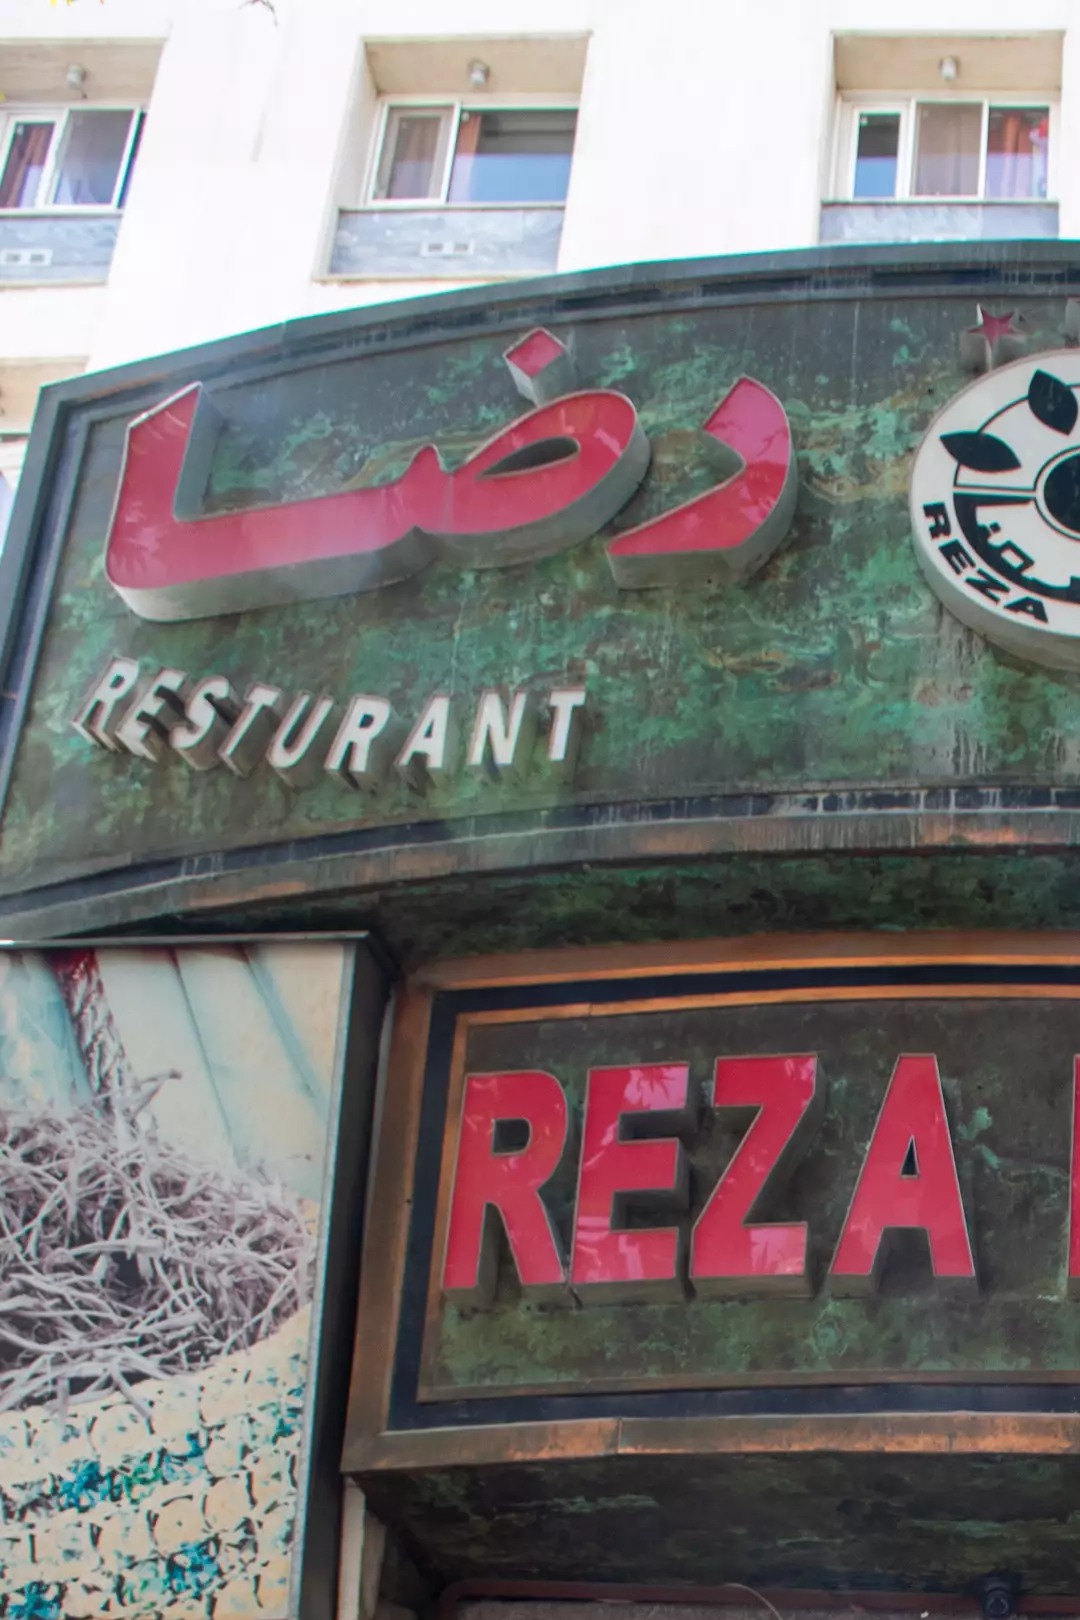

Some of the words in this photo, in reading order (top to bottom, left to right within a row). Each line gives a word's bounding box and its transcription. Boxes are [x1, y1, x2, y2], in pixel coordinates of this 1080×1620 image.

[104, 327, 800, 622] رضا
[922, 502, 1049, 624] REZA
[70, 656, 588, 785] RESTURANT
[441, 1052, 978, 1298] REZA
